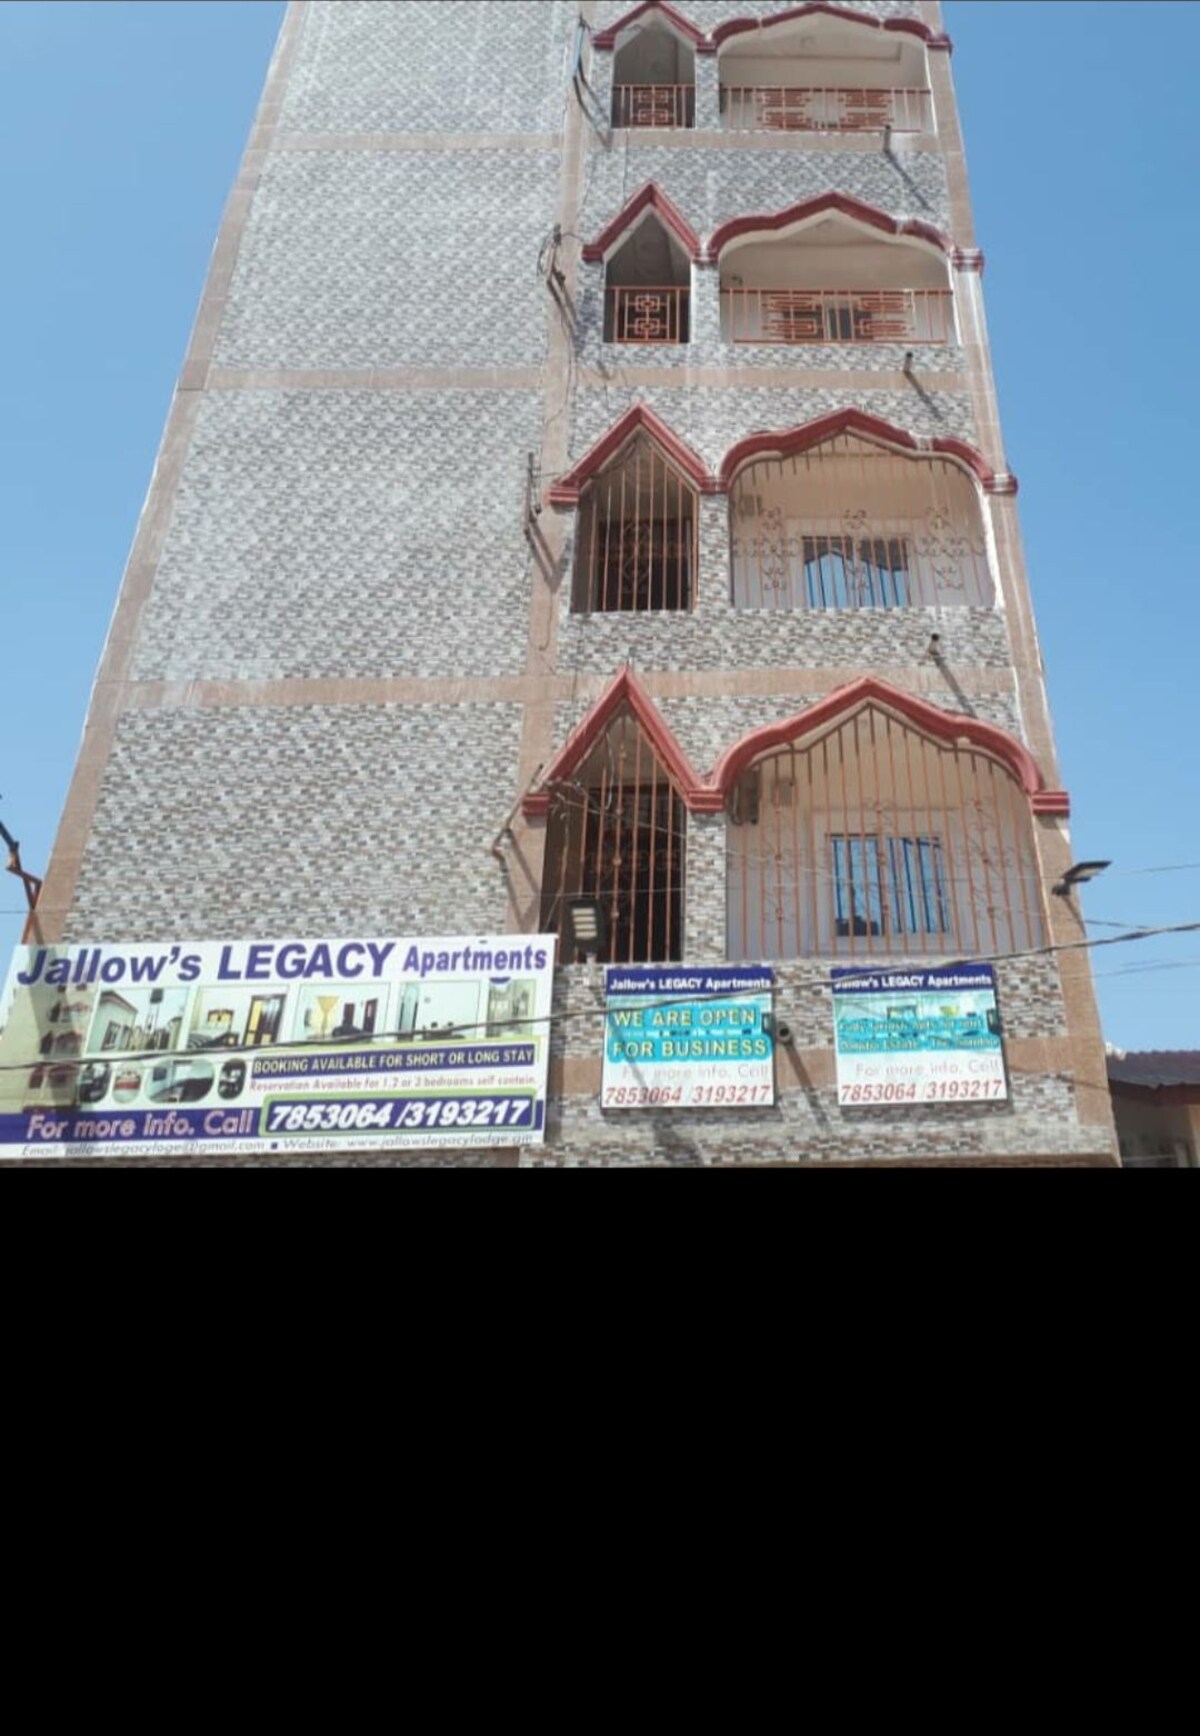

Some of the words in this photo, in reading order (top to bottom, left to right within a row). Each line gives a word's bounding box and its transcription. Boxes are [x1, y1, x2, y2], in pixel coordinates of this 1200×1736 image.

[17, 946, 202, 985] Jallow's
[217, 942, 396, 980] LEGACY
[402, 944, 548, 978] Apartments
[610, 979, 655, 990] Jallow's
[659, 978, 702, 989] LEGACY
[706, 977, 771, 990] Apartments
[881, 976, 924, 987] LEGACY
[928, 974, 993, 987] Apartments
[613, 1011, 643, 1027] WE
[652, 1010, 692, 1026] ARE
[700, 1009, 755, 1025] OPEN
[613, 1042, 653, 1058] FOR
[662, 1038, 766, 1056] BUSINESS
[252, 1059, 309, 1074] BOOKING
[311, 1055, 377, 1071] AVAILABLE
[379, 1054, 403, 1068] FOR
[406, 1051, 445, 1067] SHORT
[449, 1050, 466, 1064] OR
[468, 1049, 500, 1063] LONG
[503, 1047, 535, 1062] STAY
[249, 1080, 310, 1093] Reservation
[313, 1078, 362, 1090] Available
[605, 1086, 682, 1105] 7853064
[840, 1082, 917, 1102] 7853064
[27, 1114, 68, 1140] For
[74, 1116, 136, 1138] more
[203, 1109, 254, 1134] Call
[268, 1104, 391, 1130] 7853064
[395, 1100, 530, 1127] /3193217
